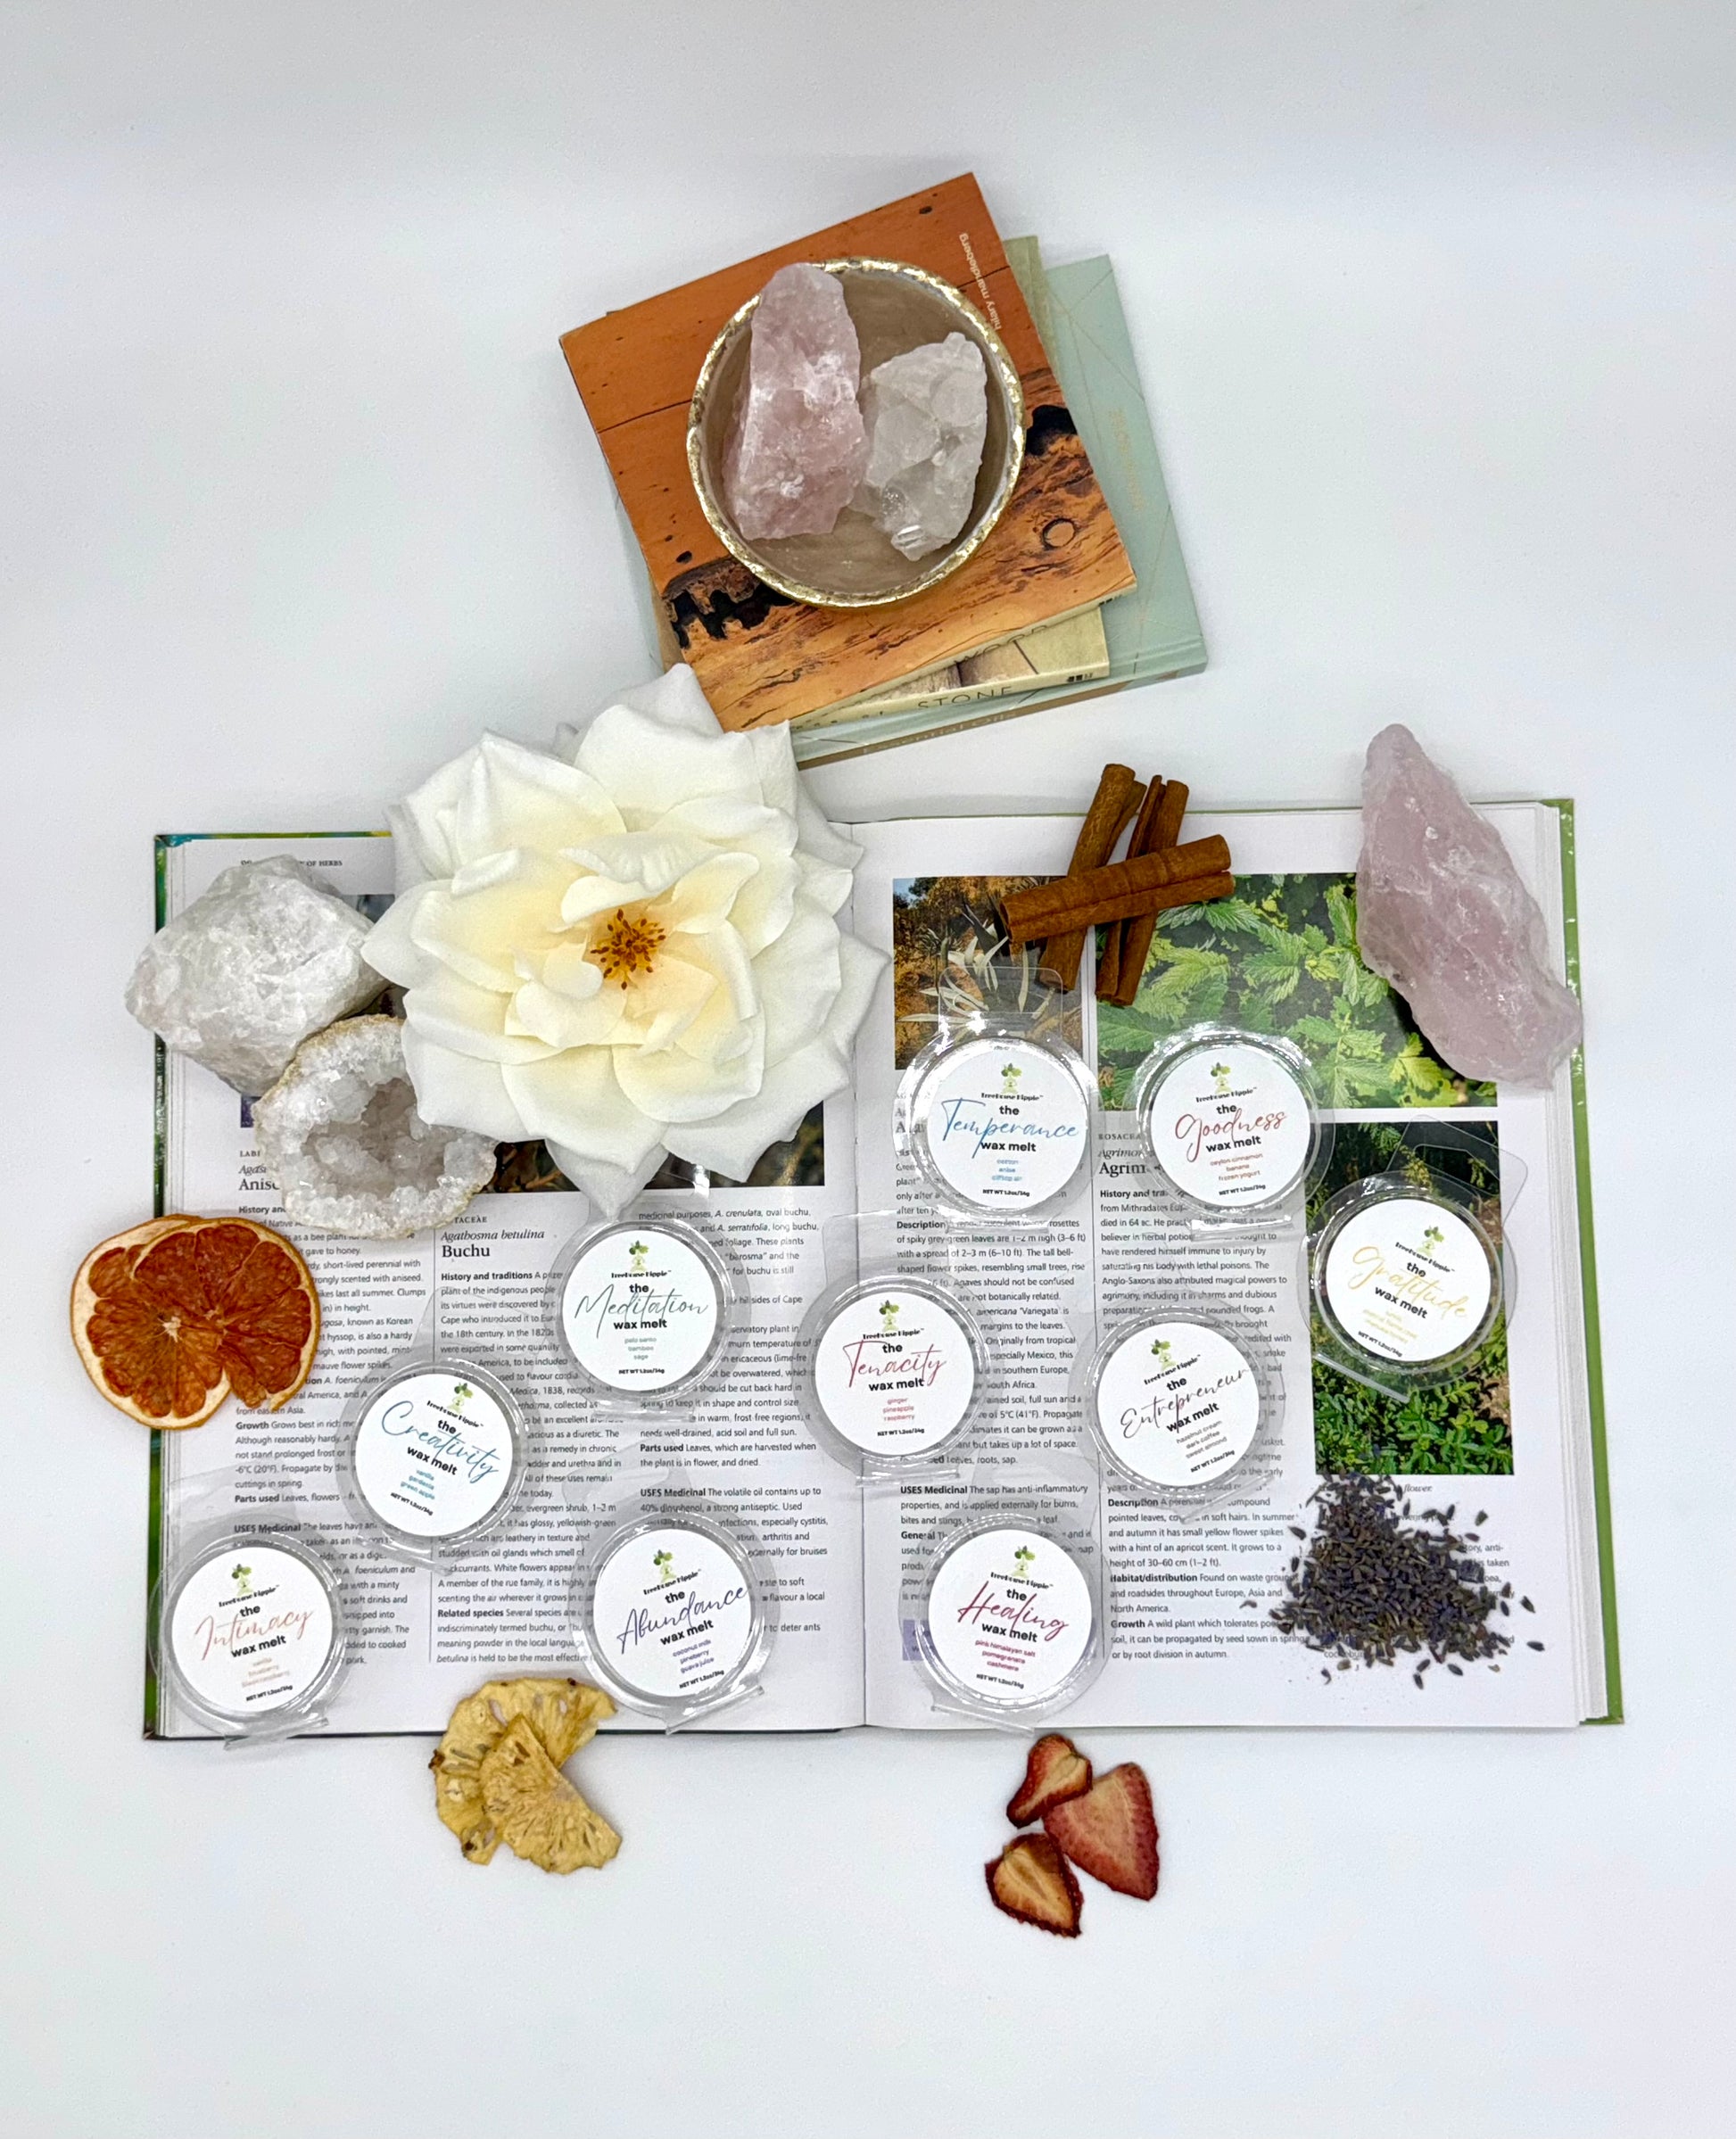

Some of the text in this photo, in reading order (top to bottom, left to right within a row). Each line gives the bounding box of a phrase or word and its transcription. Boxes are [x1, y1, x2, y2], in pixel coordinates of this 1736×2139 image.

[959, 233, 1002, 331] hilary mandleberg
[999, 1105, 1020, 1116] the
[1216, 1103, 1236, 1115] the
[941, 1097, 1079, 1159] Temperance
[980, 1141, 1037, 1152] wax melt
[1206, 1136, 1261, 1152] wax melt
[1232, 1152, 1263, 1163] cinnamon
[1219, 1169, 1261, 1181] frozen yogurt
[1100, 1189, 1150, 1199] History and
[238, 1206, 269, 1214] History
[897, 1221, 946, 1230] Description
[441, 1229, 545, 1243] Agathosma betulina
[442, 1245, 491, 1258] Buchu
[323, 1259, 421, 1270] short-lived perennial with
[1407, 1261, 1427, 1278] the
[341, 1275, 370, 1283] scented
[372, 1275, 390, 1283] with
[442, 1272, 471, 1283] History
[492, 1272, 533, 1280] traditions
[1102, 1276, 1277, 1286] Anglo-Saxons magical powers
[629, 1284, 649, 1293] the
[1375, 1285, 1428, 1319] wax melt
[575, 1284, 708, 1339] Meditation
[614, 1318, 667, 1330] wax melt
[327, 1332, 412, 1342] hyssop, is also hardy
[882, 1343, 903, 1353] the
[843, 1339, 947, 1388] Tenacity
[868, 1378, 924, 1392] wax melt
[1166, 1376, 1187, 1392] the
[887, 1398, 908, 1406] ginger
[1120, 1368, 1250, 1438] Entrepreneur
[882, 1405, 914, 1414] pineapple
[884, 1413, 914, 1422] raspberry
[1166, 1403, 1219, 1433] wax melt
[236, 1421, 315, 1431] Growth Grows best
[437, 1419, 457, 1434] the
[1176, 1420, 1222, 1444] hazelnut cream
[381, 1400, 500, 1484] Creativity
[1186, 1431, 1220, 1449] dark coffee
[1204, 1436, 1228, 1450] almond
[641, 1443, 662, 1452] Parts
[664, 1443, 684, 1452] used
[686, 1443, 712, 1452] Leaves,
[715, 1443, 739, 1451] which
[755, 1442, 792, 1451] harvested
[794, 1442, 816, 1450] when
[407, 1446, 458, 1475] wax melt
[400, 1482, 417, 1494] green
[765, 1487, 798, 1496] contains
[900, 1486, 968, 1494] USES Medicinal
[235, 1494, 279, 1503] Parts used
[1110, 1573, 1225, 1582] Habitat/distribution Found
[438, 1579, 444, 1588] A
[446, 1579, 478, 1588] member
[480, 1579, 489, 1588] of
[491, 1579, 503, 1587] the
[520, 1579, 544, 1590] family,
[665, 1590, 685, 1604] the
[1006, 1589, 1027, 1601] the
[239, 1605, 260, 1617] the
[438, 1608, 562, 1618] Related species Several species
[957, 1581, 1069, 1642] Healing
[1111, 1605, 1170, 1613] North America.
[616, 1586, 748, 1655] Abundance
[1111, 1619, 1222, 1629] Growth A wild plant which
[194, 1610, 313, 1661] Intimacy
[660, 1619, 714, 1646] wax melt
[981, 1623, 1038, 1643] wax melt
[231, 1635, 287, 1658] wax melt
[673, 1644, 699, 1656] coconut
[975, 1639, 1036, 1657] pink himalayan salt
[699, 1657, 715, 1667] juice
[981, 1650, 1026, 1664] pomegranate
[987, 1660, 1019, 1672] cashmere
